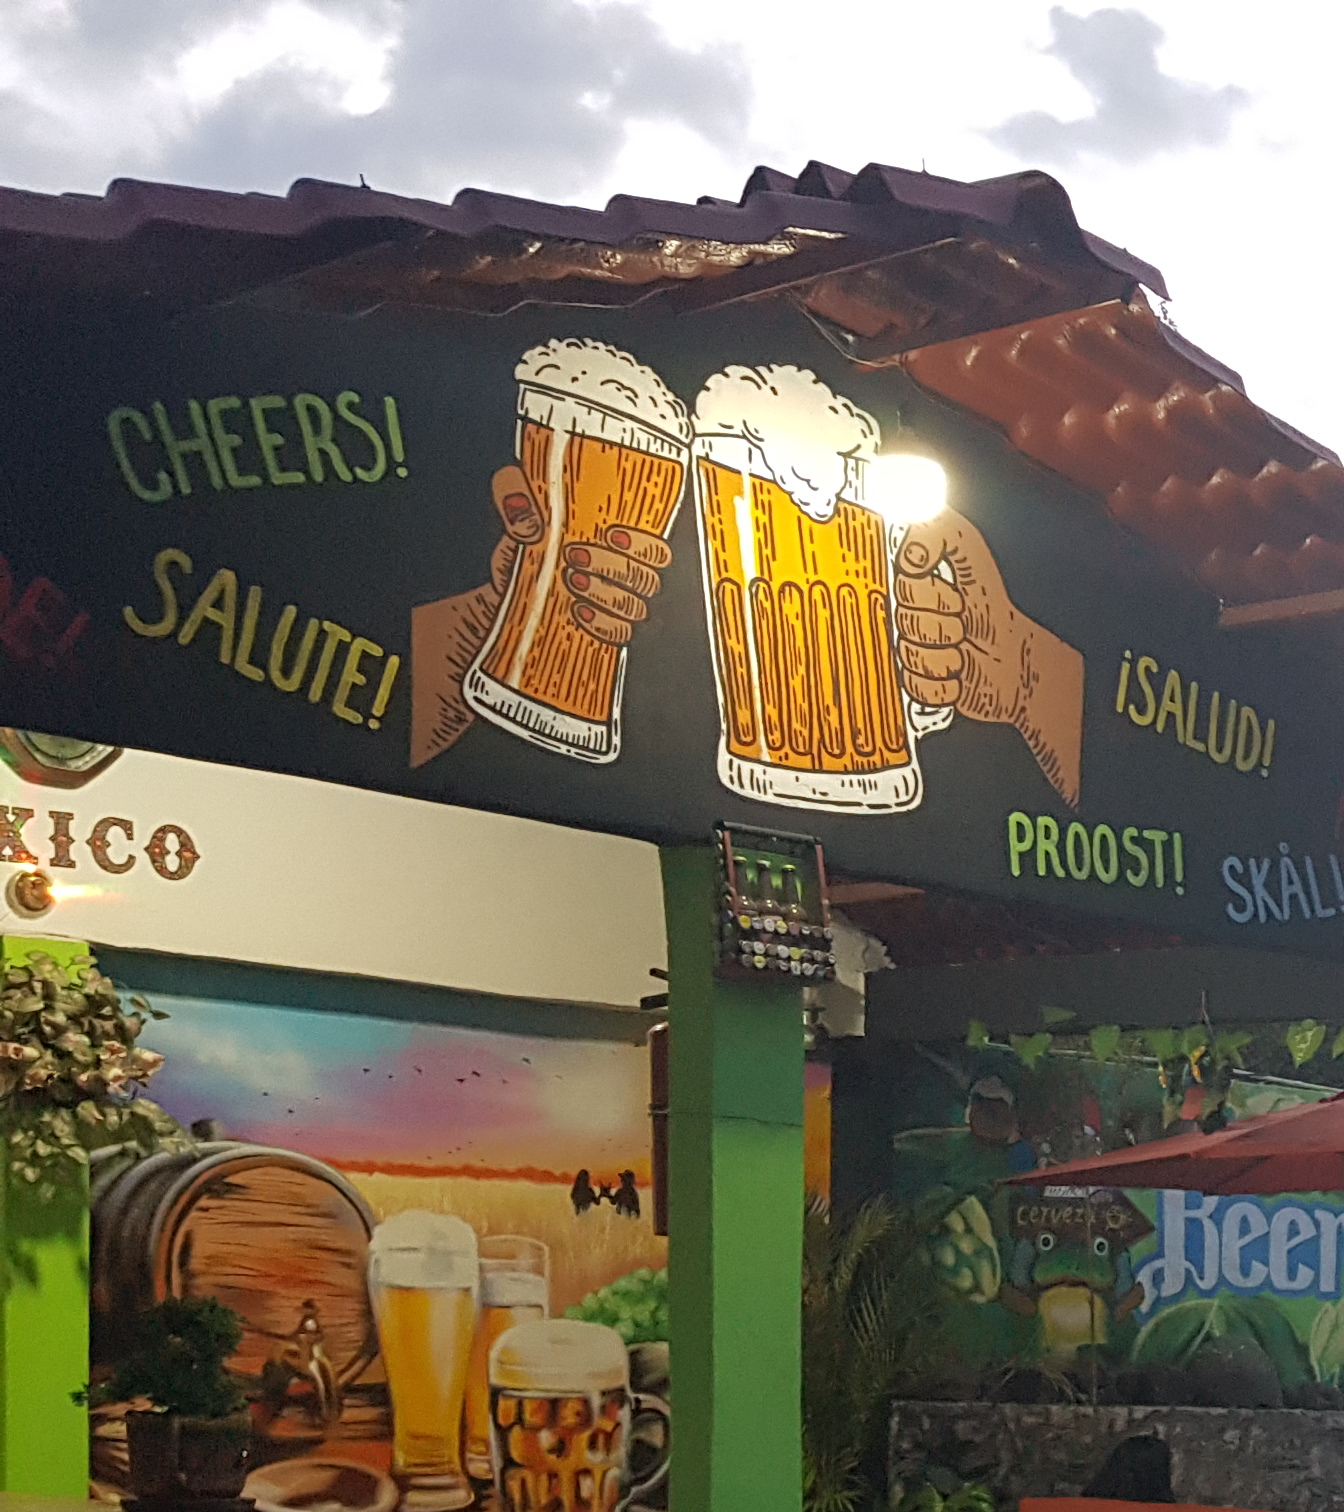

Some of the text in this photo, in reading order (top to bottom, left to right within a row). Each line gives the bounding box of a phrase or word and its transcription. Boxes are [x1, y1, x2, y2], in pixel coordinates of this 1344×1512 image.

[107, 390, 408, 501] CHEERS!
[122, 548, 400, 730] SALUTE!
[1114, 649, 1276, 779] ¡SALUD!
[1007, 810, 1185, 897] PROOST!
